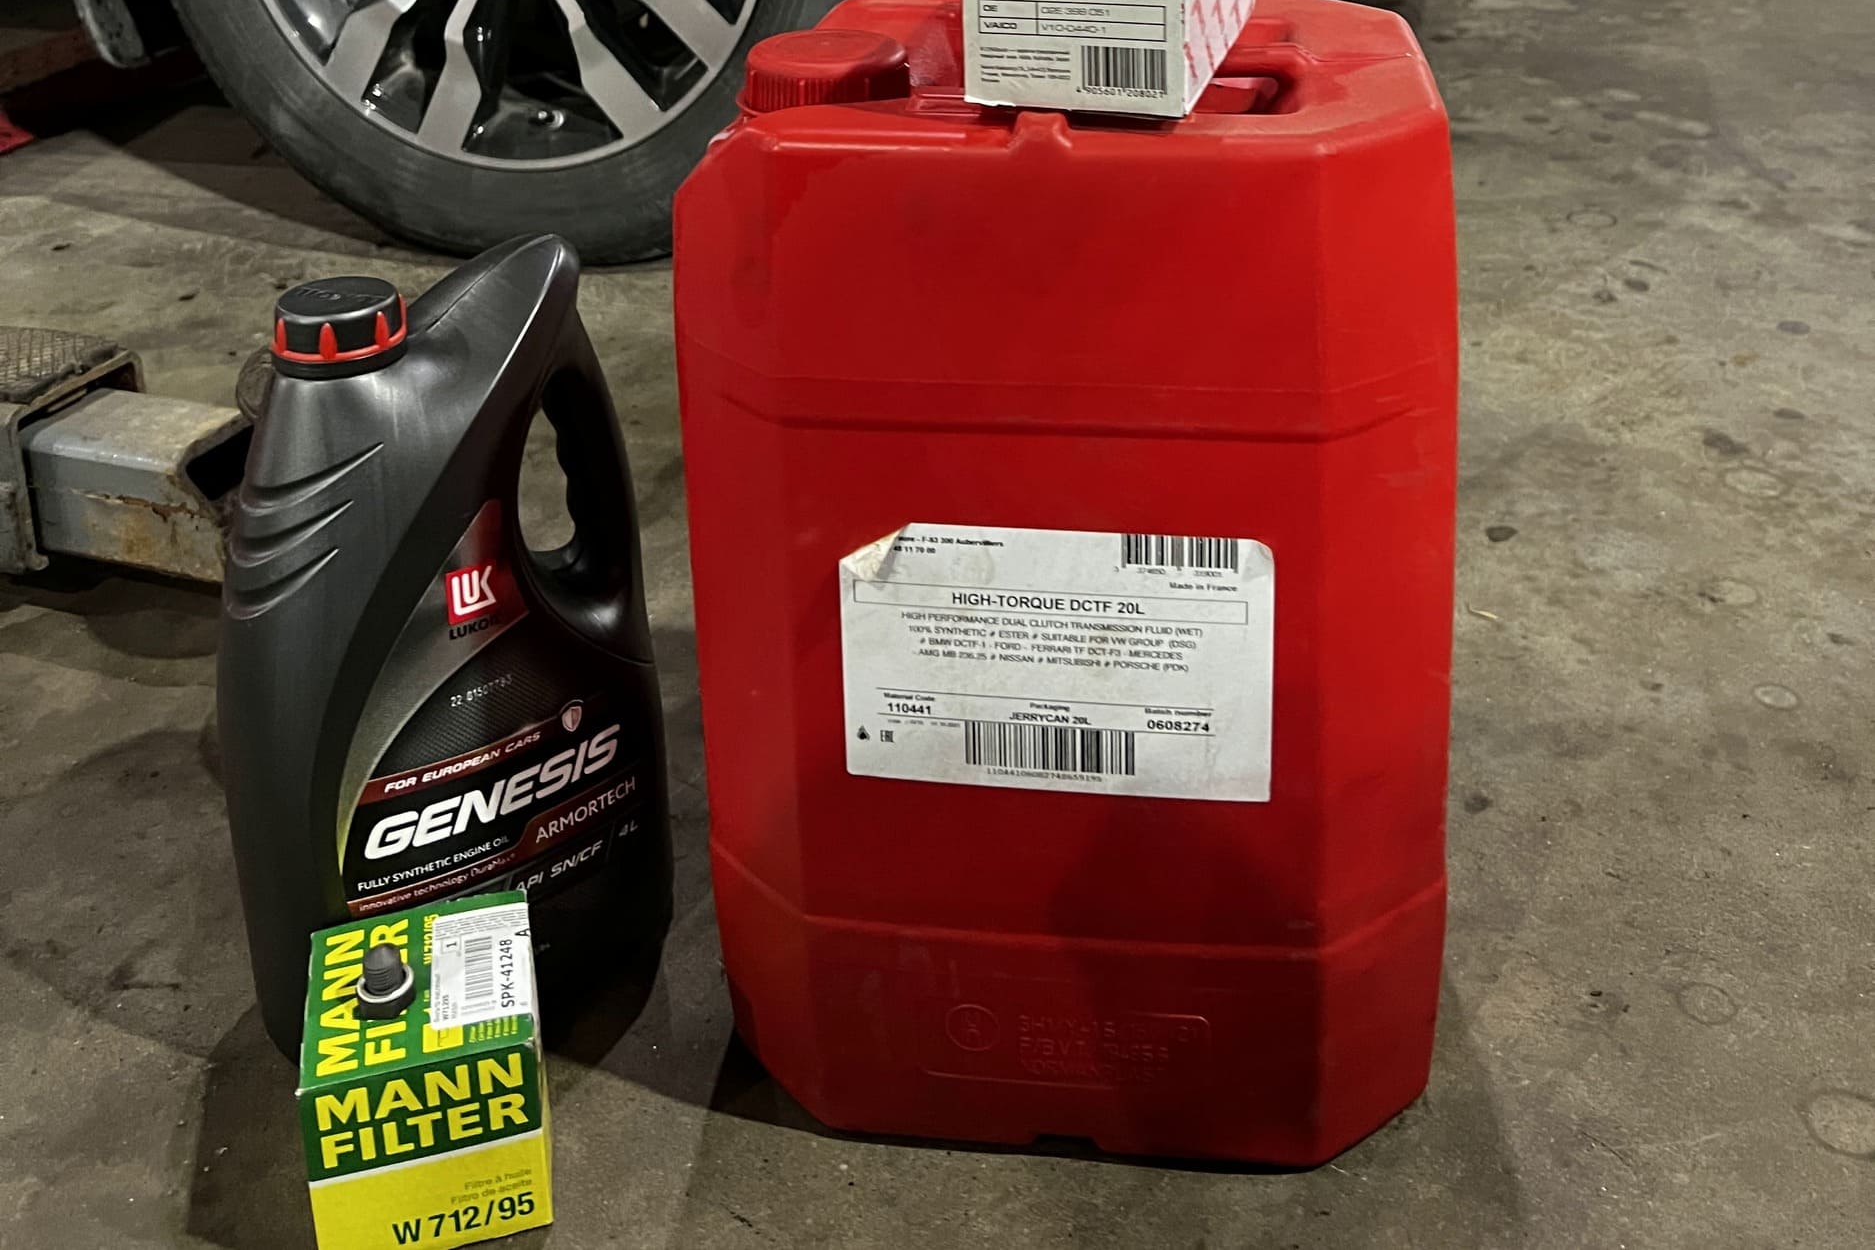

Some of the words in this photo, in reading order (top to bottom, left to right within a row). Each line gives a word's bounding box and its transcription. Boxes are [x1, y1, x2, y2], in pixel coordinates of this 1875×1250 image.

[983, 21, 1017, 30] VAICO
[1169, 582, 1193, 590] Made
[1195, 582, 1204, 590] in
[1206, 584, 1238, 592] France
[951, 592, 1065, 611] HIGH-TORQUE
[1069, 597, 1113, 613] DCTF
[1117, 600, 1145, 615] 20L
[901, 612, 926, 621] HIGH
[927, 613, 999, 625] PERFORMANCE
[1001, 617, 1028, 627] DUAL
[1029, 619, 1068, 629] CLUTCH
[1069, 621, 1143, 633] TRANSMISSION
[1144, 626, 1173, 635] FLUID
[1174, 627, 1203, 637] (WET)
[908, 625, 932, 634] 100%
[934, 626, 987, 637] SYNTHETIC
[998, 630, 1029, 639] ESTER
[1041, 633, 1087, 644] SUITABLE
[1088, 635, 1109, 644] FOR
[1110, 636, 1127, 645] VW
[1128, 637, 1164, 647] GROUP
[1168, 639, 1197, 649] (DSG)
[928, 637, 952, 646] BMW
[994, 641, 1022, 650] FORD
[1031, 643, 1072, 654] FERRARI
[1128, 650, 1183, 660] MERCEDES
[918, 648, 939, 657] AMG
[942, 650, 957, 658] MB
[999, 653, 1034, 663] NISSAN
[1046, 657, 1101, 667] MITSUBISHI
[1113, 661, 1160, 671] PORSCHE
[1162, 662, 1189, 672] (PDK)
[883, 692, 913, 701] Material
[887, 702, 932, 715] 110441
[1029, 702, 1070, 712] Packaging
[1009, 711, 1070, 724] JERRYCAN
[1072, 716, 1092, 725] 20L
[1174, 709, 1212, 717] number
[1146, 719, 1210, 732] 0608274
[384, 776, 417, 794] FOR
[421, 748, 501, 783] EUROPEAN
[504, 731, 541, 754] CARS
[364, 723, 621, 860] GENESIS
[535, 775, 636, 844] ARMORTECH
[618, 819, 639, 837] 4L
[357, 875, 391, 892] FULLY
[392, 857, 452, 883] SYNTHETIC
[453, 843, 492, 863] ENGINE
[492, 836, 510, 851] OIL
[516, 871, 544, 894] API
[550, 840, 603, 878] SN/CF
[358, 892, 412, 913] innovative
[413, 873, 470, 898] technology
[514, 928, 530, 937] A
[499, 939, 515, 1008] SPK-41248
[316, 929, 365, 1077] MANN
[364, 918, 409, 1065] FIR
[315, 1052, 524, 1132] MANN
[320, 1093, 529, 1169] FILTER
[451, 1192, 479, 1205] Filtro
[481, 1187, 497, 1198] de
[498, 1178, 533, 1193] aceite
[464, 1178, 493, 1191] Filtre
[504, 1168, 532, 1181] huile
[392, 1218, 421, 1245] W
[428, 1191, 535, 1238] 712/95
